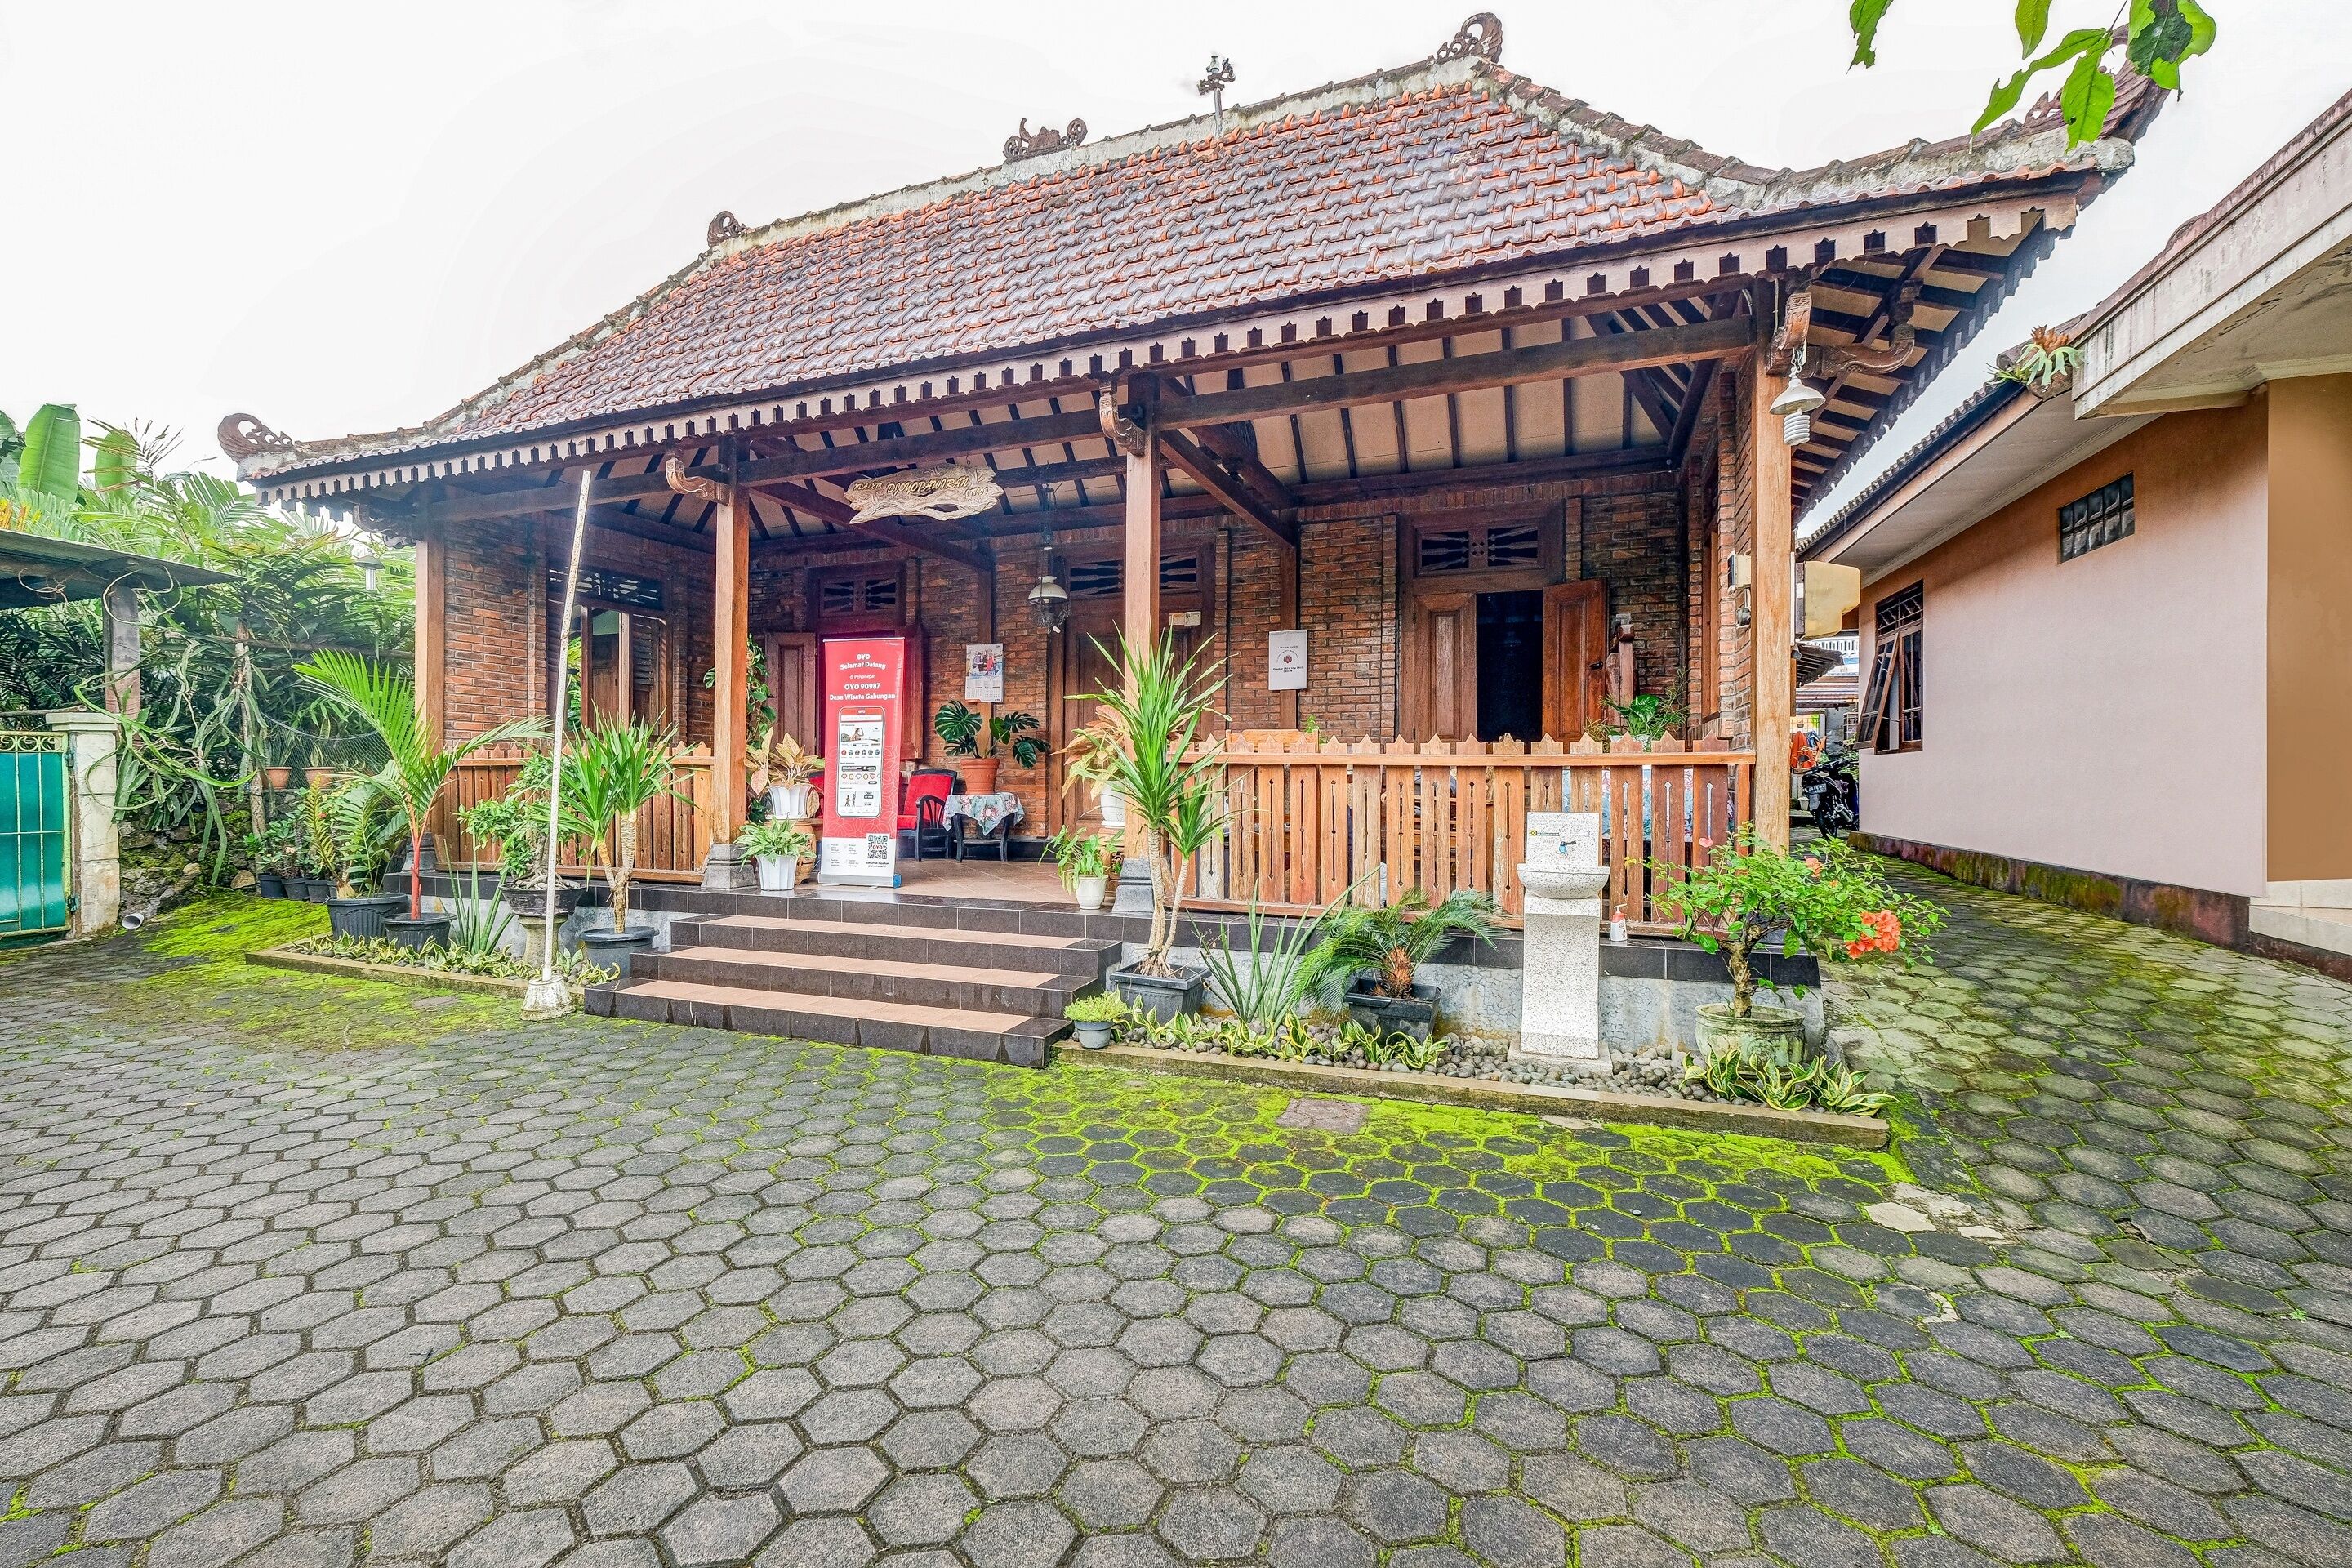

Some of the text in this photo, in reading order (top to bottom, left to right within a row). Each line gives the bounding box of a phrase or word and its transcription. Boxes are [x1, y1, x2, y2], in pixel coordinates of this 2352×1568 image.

[886, 476, 969, 496] DJOYOPAWIRAN
[840, 662, 886, 670] Selamat Datang
